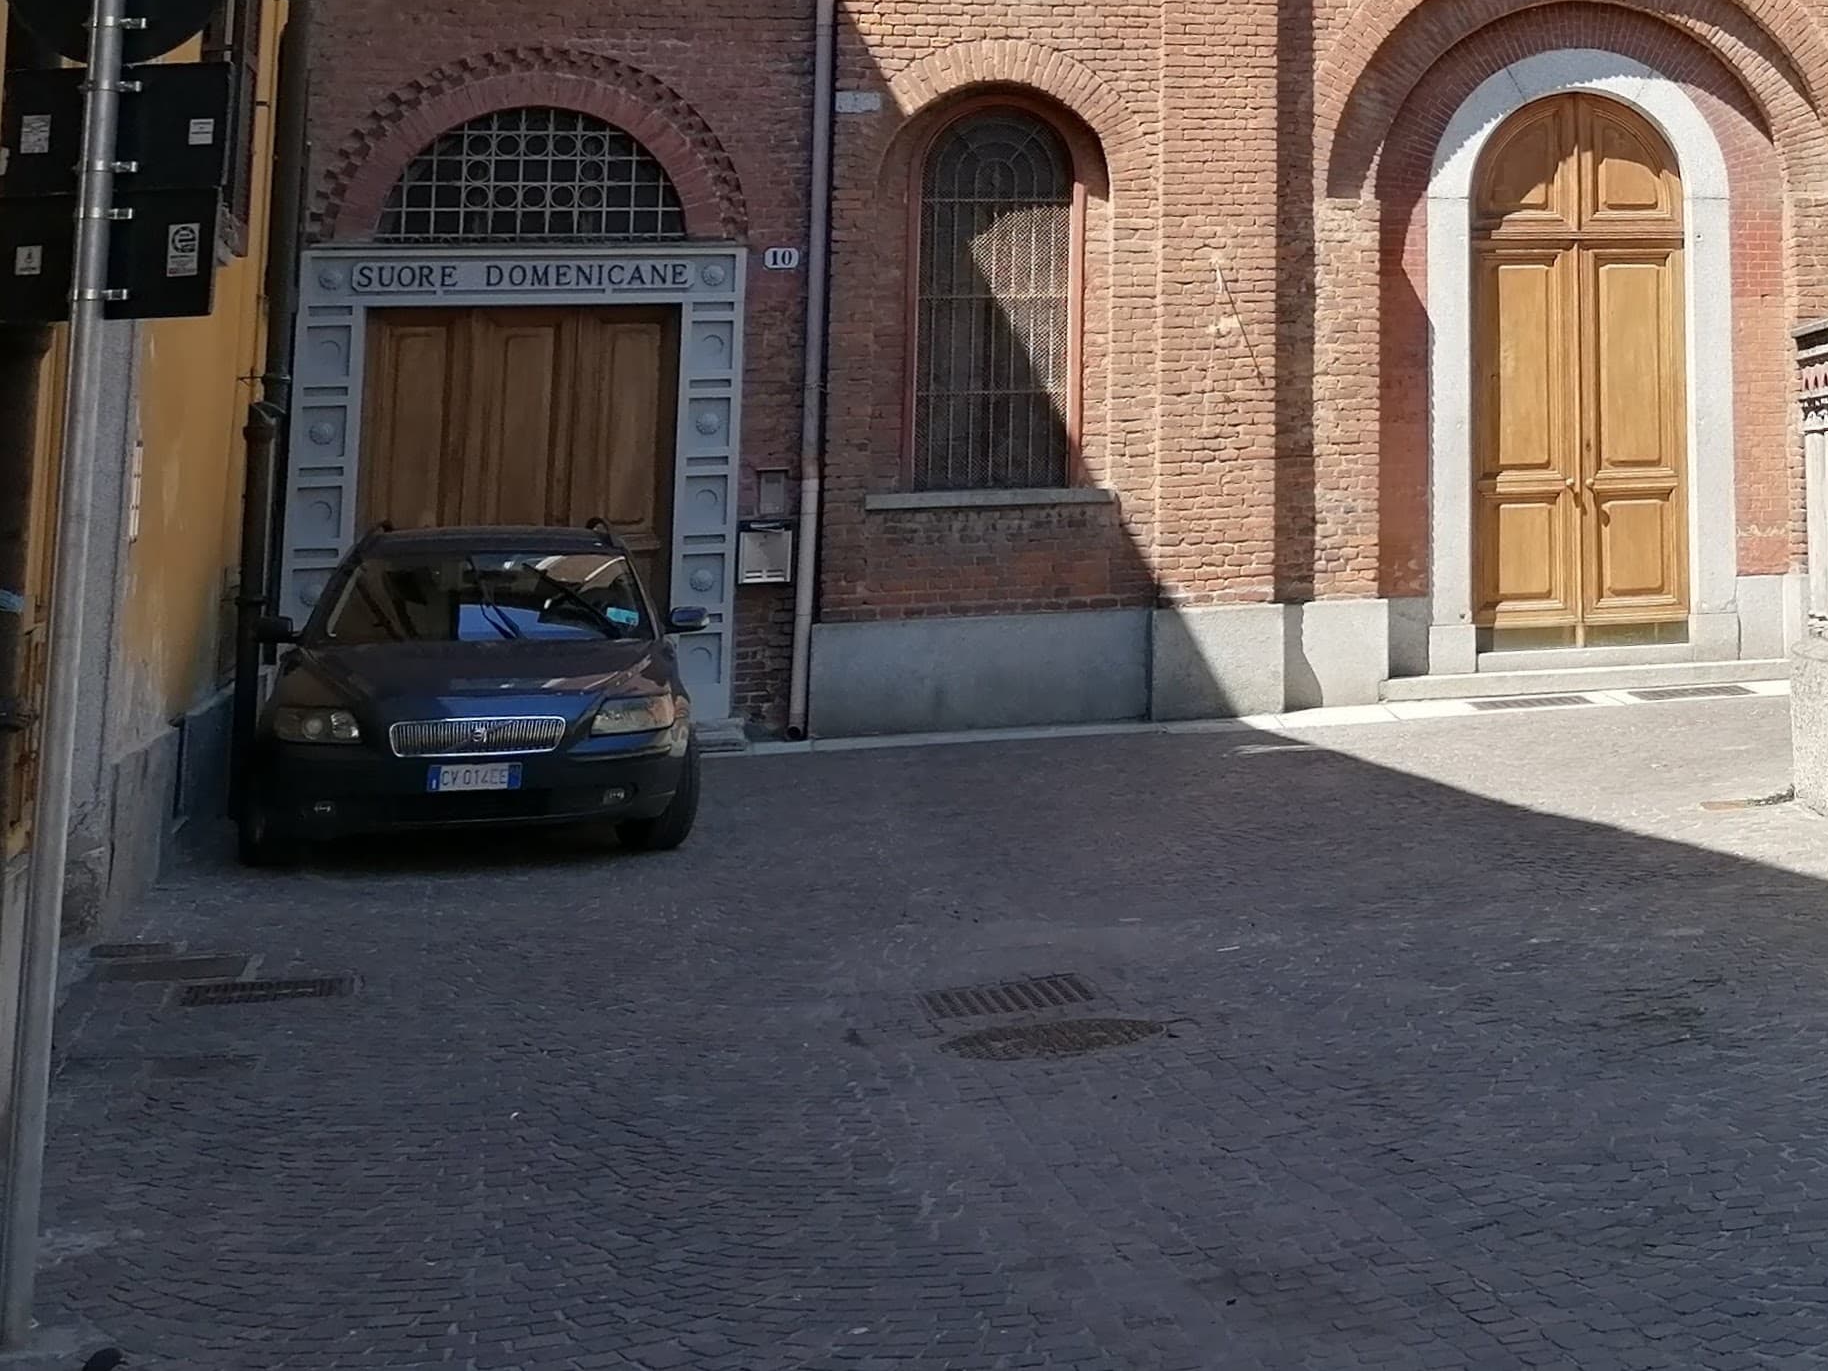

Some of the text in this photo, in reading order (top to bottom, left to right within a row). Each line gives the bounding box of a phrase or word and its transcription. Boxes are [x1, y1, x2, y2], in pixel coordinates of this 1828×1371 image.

[771, 250, 793, 266] 10
[357, 263, 689, 289] SUORE DOMENICANE
